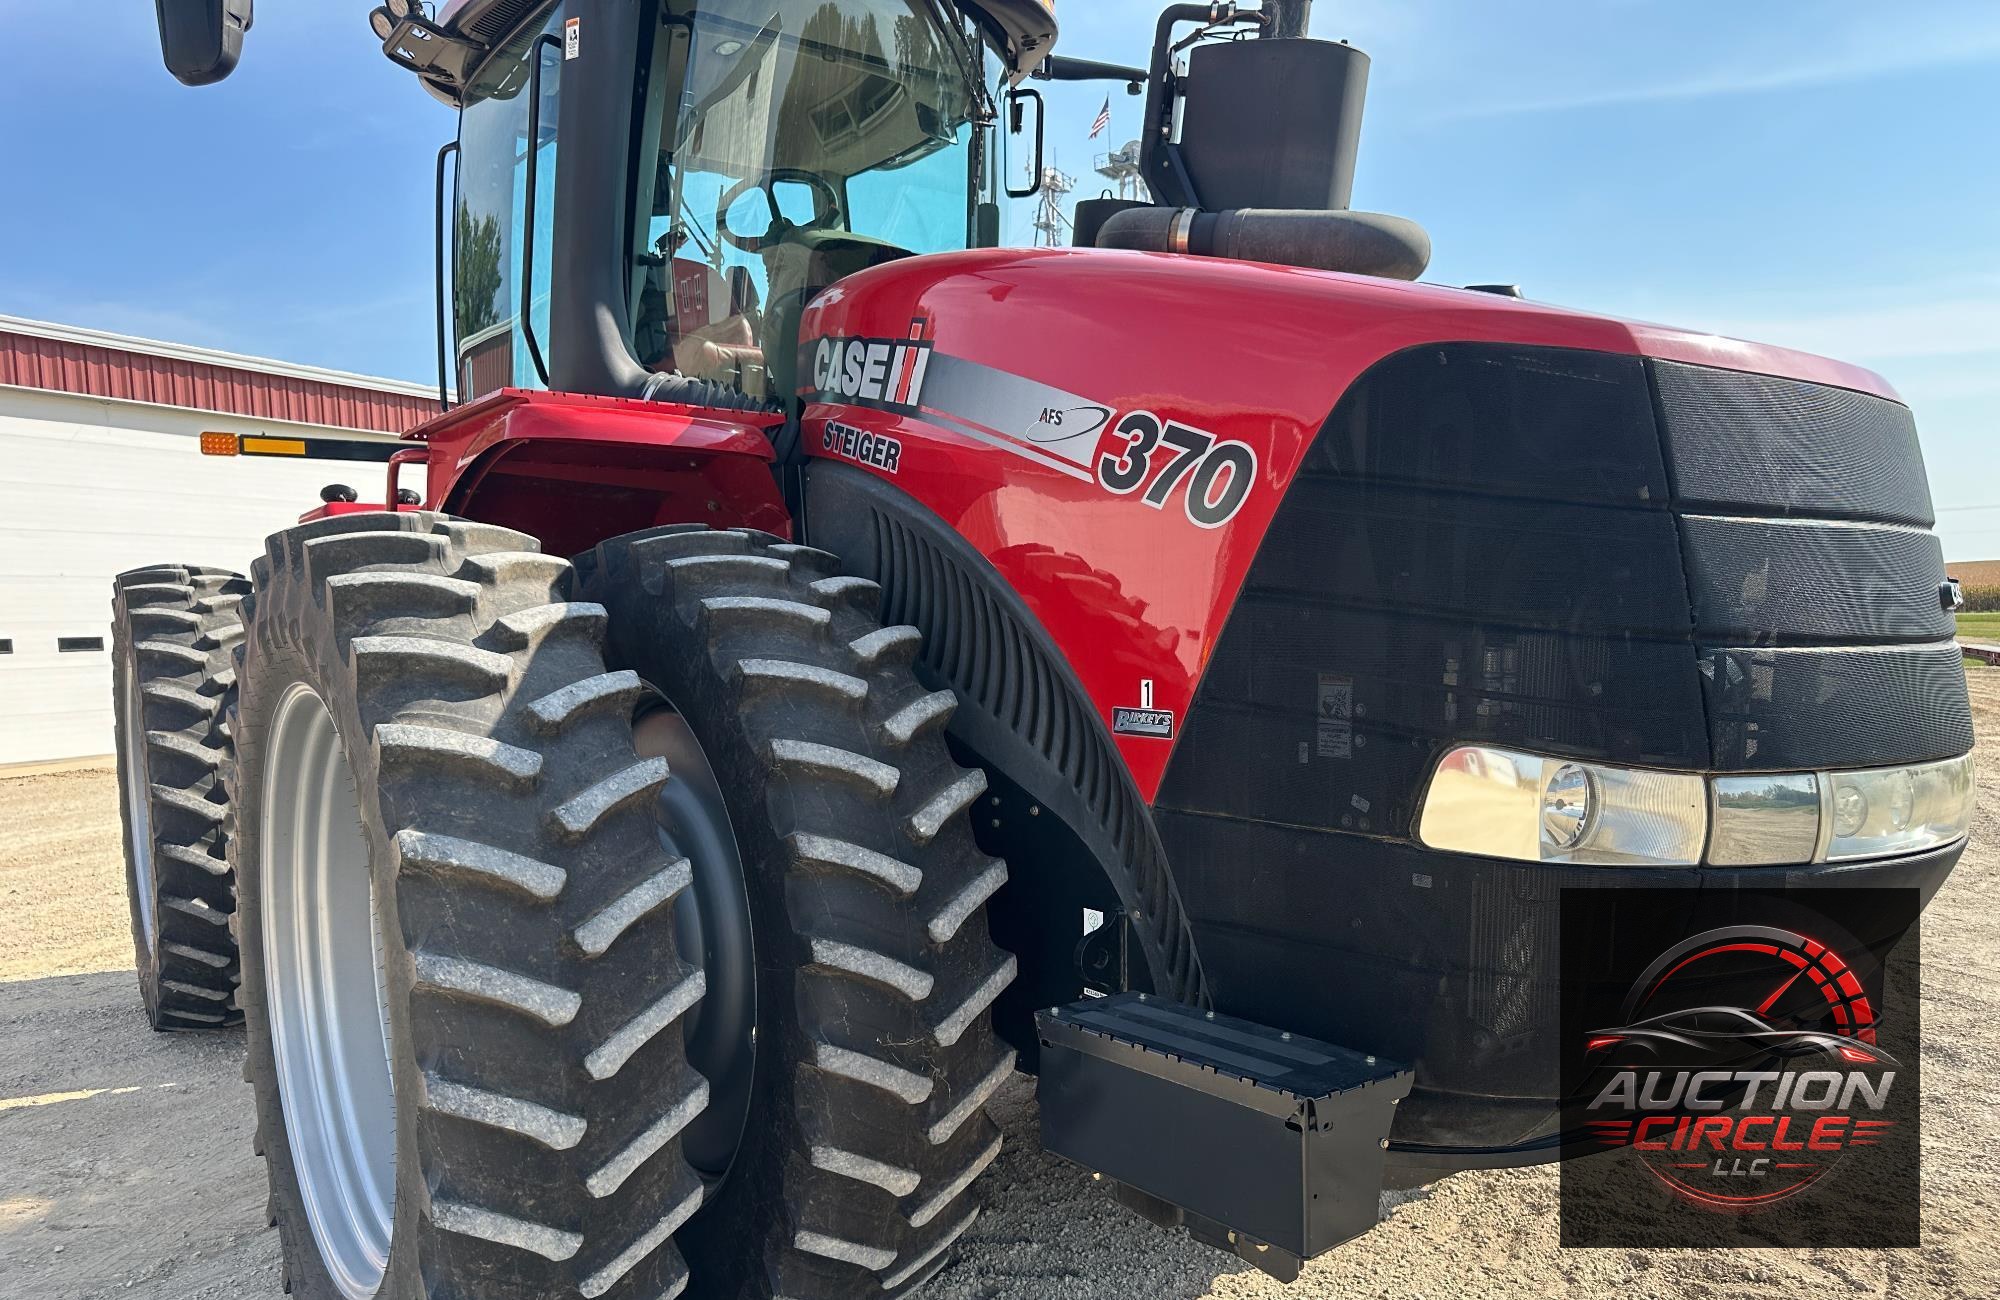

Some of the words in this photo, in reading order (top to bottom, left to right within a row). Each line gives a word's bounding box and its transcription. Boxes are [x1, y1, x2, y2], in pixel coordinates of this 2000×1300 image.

[814, 337, 890, 400] CASE
[1038, 407, 1063, 426] AFS
[823, 420, 901, 474] STEIGER
[1098, 410, 1258, 529] 370
[1144, 681, 1150, 707] 1
